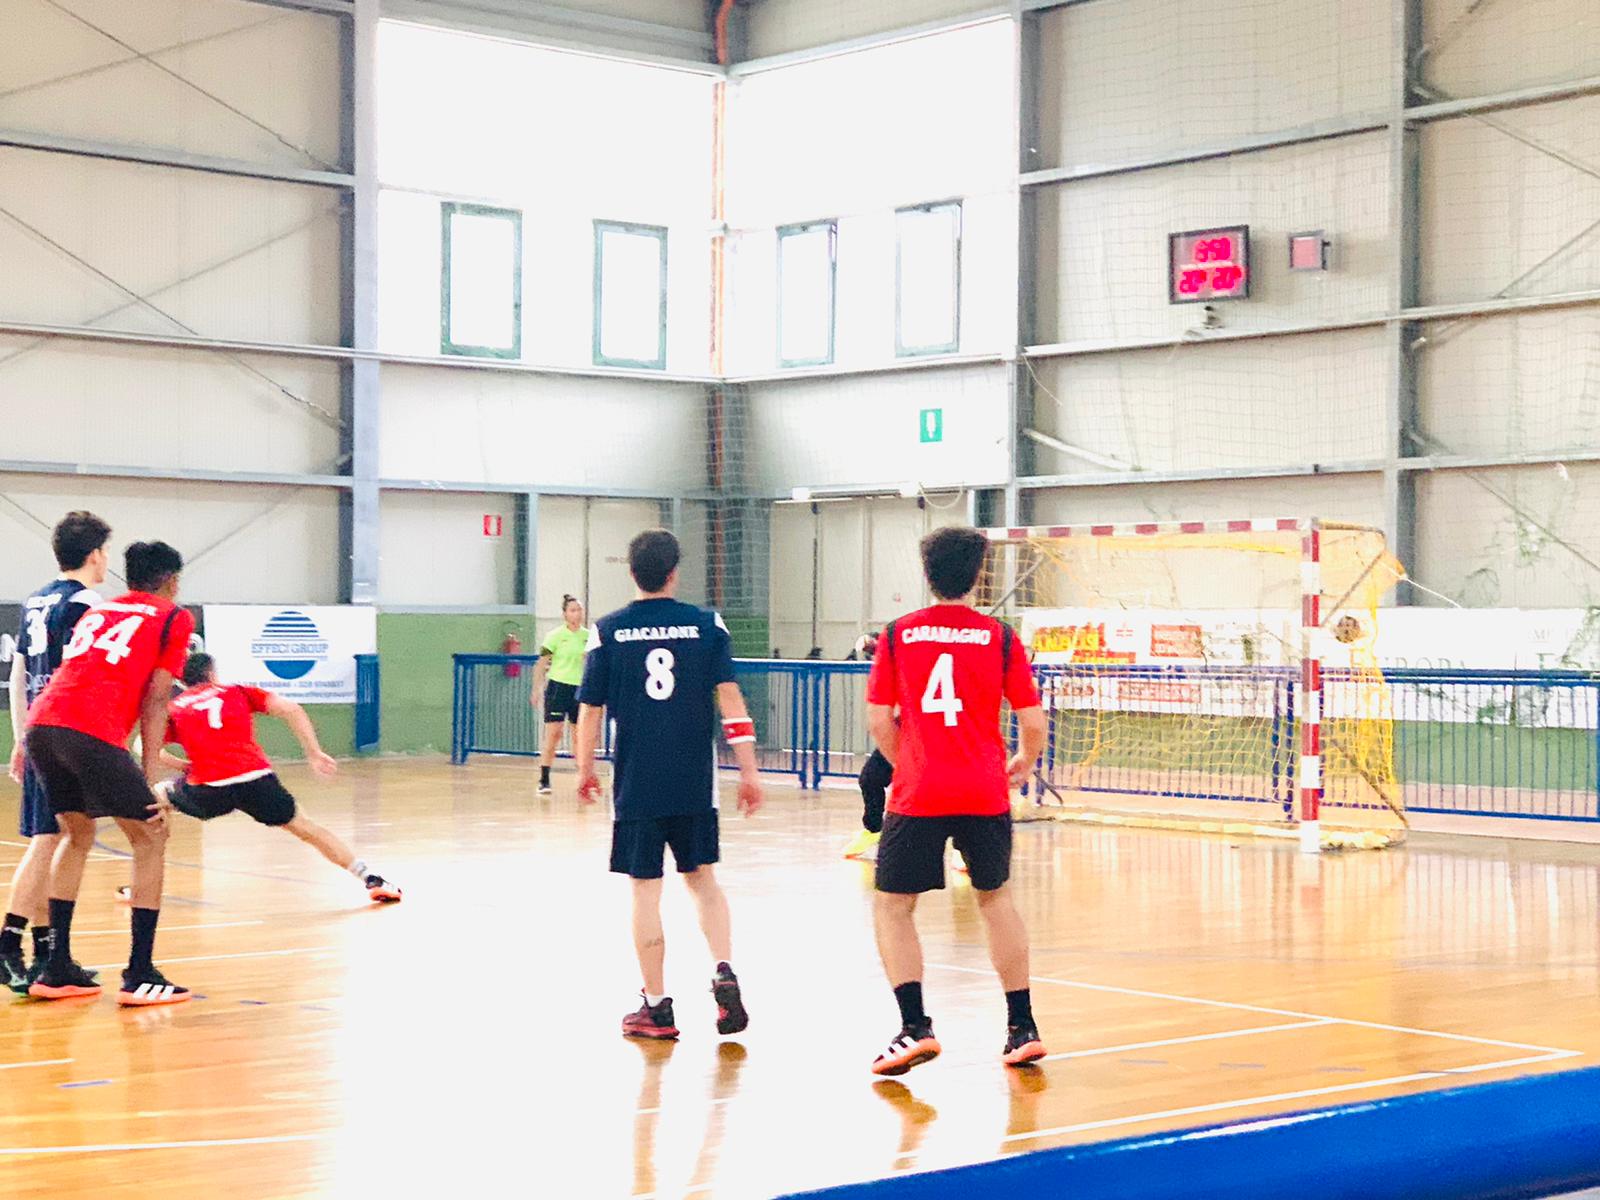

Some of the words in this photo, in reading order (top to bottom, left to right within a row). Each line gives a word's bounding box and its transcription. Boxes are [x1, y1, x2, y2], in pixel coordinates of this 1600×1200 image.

[613, 625, 700, 643] GIACALONE
[901, 625, 991, 646] CARAMAGNO
[290, 642, 329, 654] GROUP
[645, 647, 675, 700] 8
[921, 652, 963, 727] 4
[192, 697, 224, 730] 7
